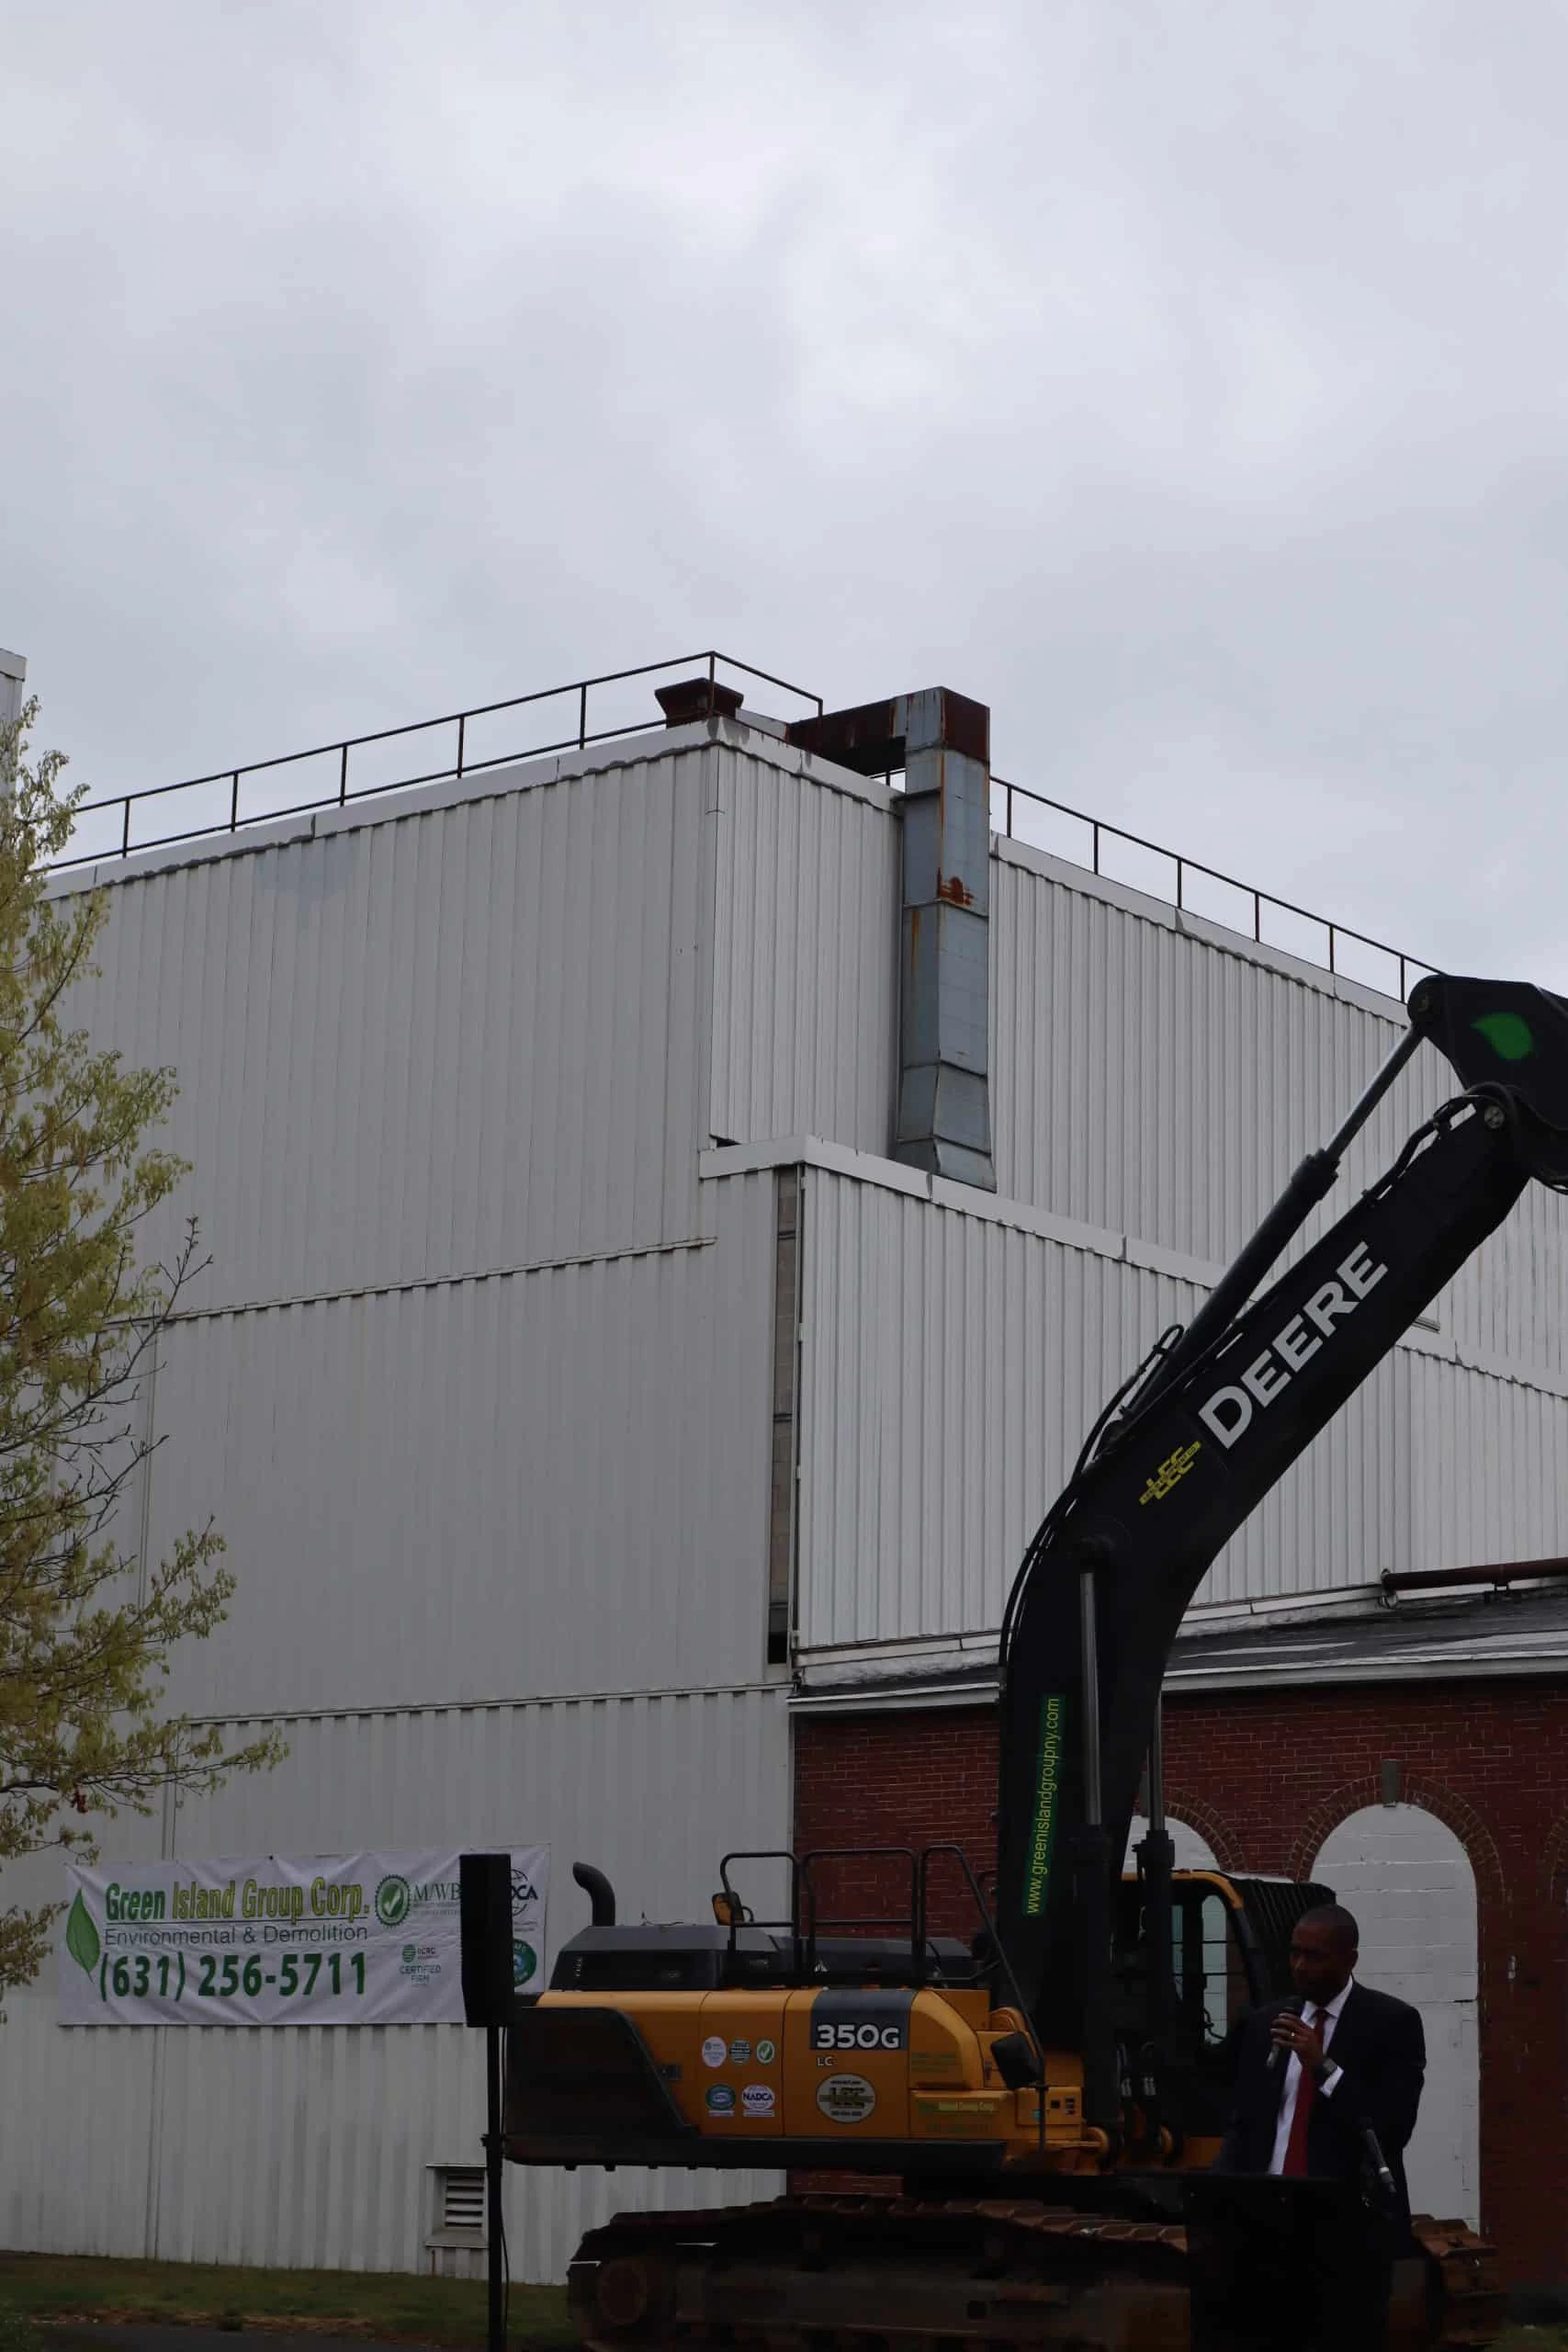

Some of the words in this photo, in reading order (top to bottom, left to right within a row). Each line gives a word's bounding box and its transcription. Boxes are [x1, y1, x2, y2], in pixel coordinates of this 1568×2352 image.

[1197, 1241, 1389, 1449] DEERE
[1026, 1697, 1062, 1916] www.greenislandgroupny.com
[105, 1883, 165, 1920] Green
[172, 1880, 236, 1919] Island
[242, 1879, 303, 1925] Group
[311, 1876, 369, 1923] Corp.
[413, 1883, 462, 1901] M/WB
[105, 1927, 235, 1945] Environmental
[243, 1926, 256, 1943] &
[264, 1924, 368, 1943] Demolition
[100, 1951, 186, 2001] (631)
[197, 1952, 366, 1996] 256-5711
[816, 2024, 900, 2050] 350G
[743, 2092, 773, 2102] NADCA
